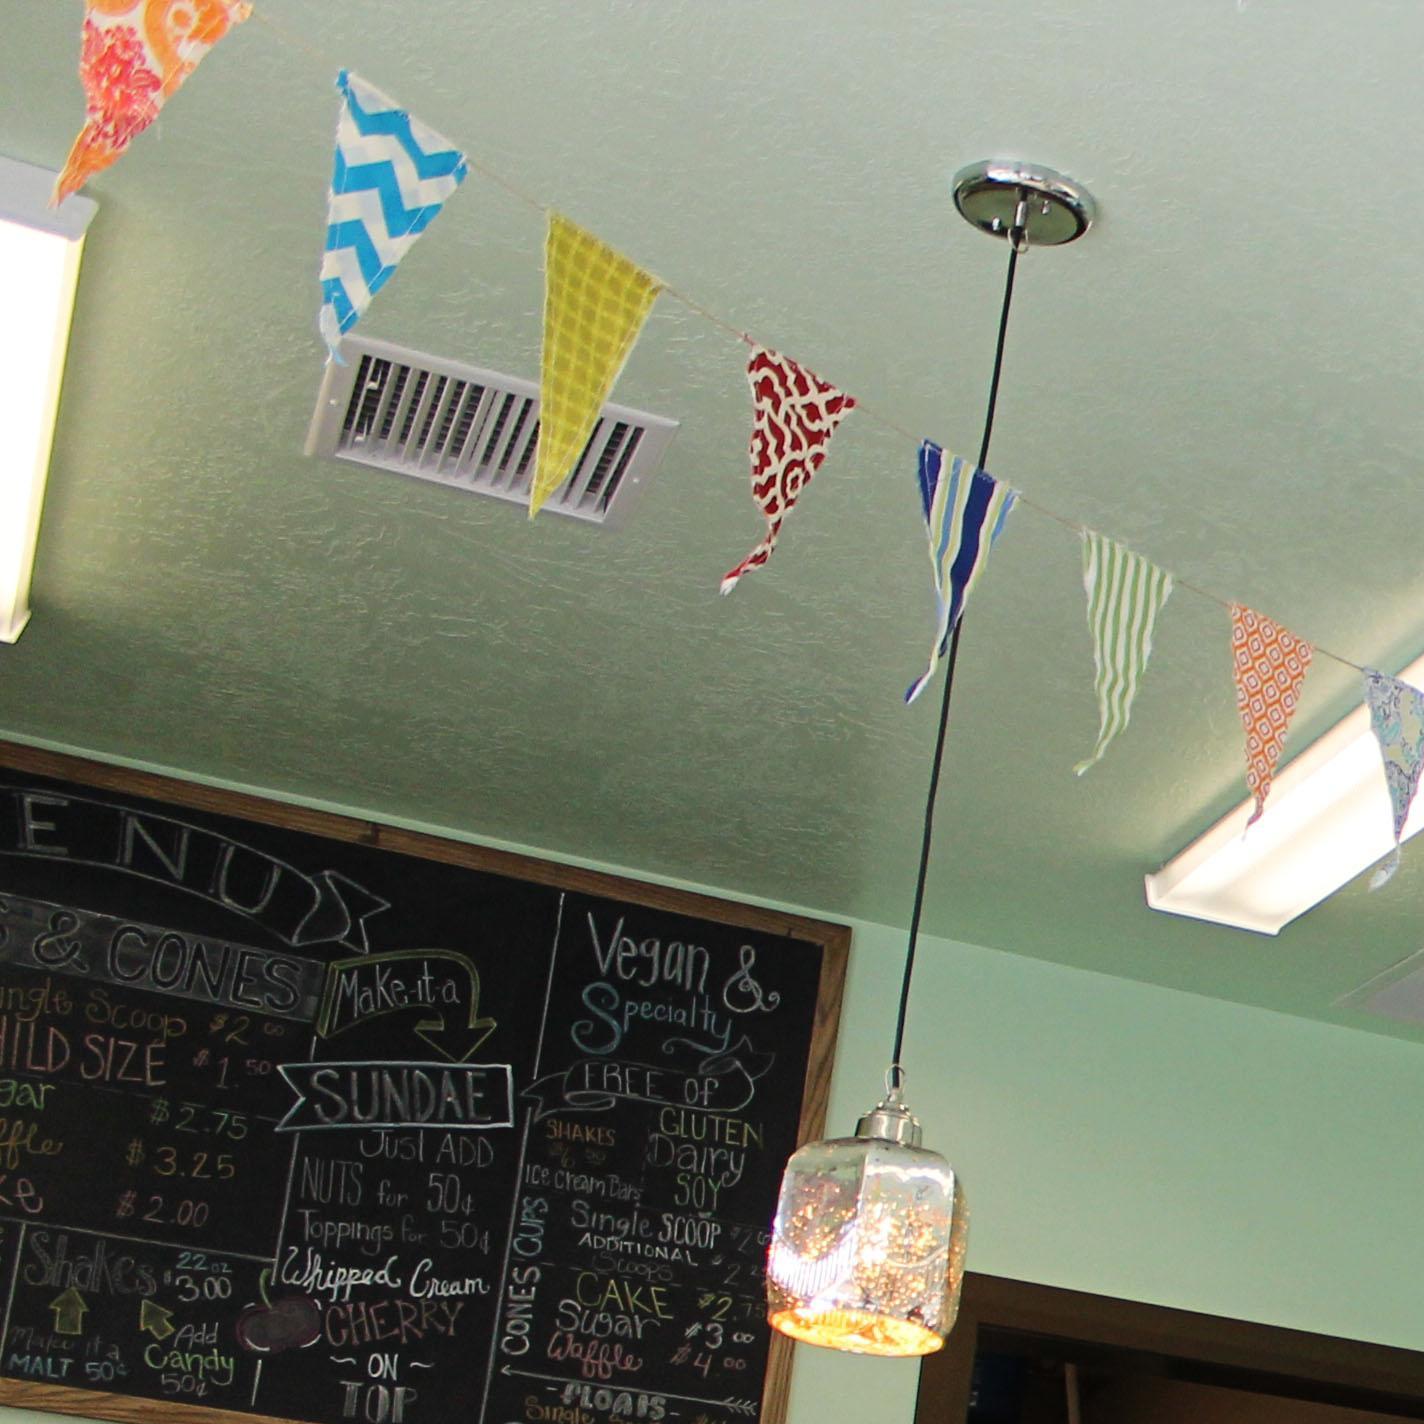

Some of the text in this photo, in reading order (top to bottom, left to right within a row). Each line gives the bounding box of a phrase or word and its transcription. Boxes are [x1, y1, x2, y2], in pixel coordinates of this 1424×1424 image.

[32, 910, 90, 973] &
[107, 924, 302, 1013] CONES
[587, 911, 781, 1013] Vegan &
[85, 988, 187, 1044] Scoop
[570, 981, 734, 1054] Specialty
[80, 1033, 167, 1087] SIZE
[584, 1062, 664, 1099] FREE
[309, 1069, 492, 1125] SUNDAE
[436, 1132, 495, 1168] ADD
[545, 1119, 616, 1147] SHAKES
[659, 1106, 764, 1149] GLUTEN
[301, 1155, 363, 1207] NUTS
[647, 1132, 745, 1188] Dairy
[674, 1172, 722, 1211] SOY
[298, 1209, 393, 1256] Toppings
[512, 1196, 549, 1257] CUPS
[570, 1199, 654, 1239] Single
[657, 1212, 722, 1250] SCOOP
[577, 1231, 699, 1267] ADDITIONAL
[23, 1231, 158, 1297] Shakes
[280, 1245, 491, 1303] Whipped Cream
[500, 1265, 541, 1356] CONES
[555, 1299, 661, 1341] Sugar
[576, 1271, 676, 1320] CAKE
[174, 1322, 220, 1349] Add
[325, 1300, 465, 1347] CHERRY
[8, 1353, 75, 1379] MALT
[144, 1343, 236, 1386] Candy
[367, 1353, 400, 1382] ON
[548, 1331, 643, 1380] Waffle
[339, 1379, 418, 1424] TOP
